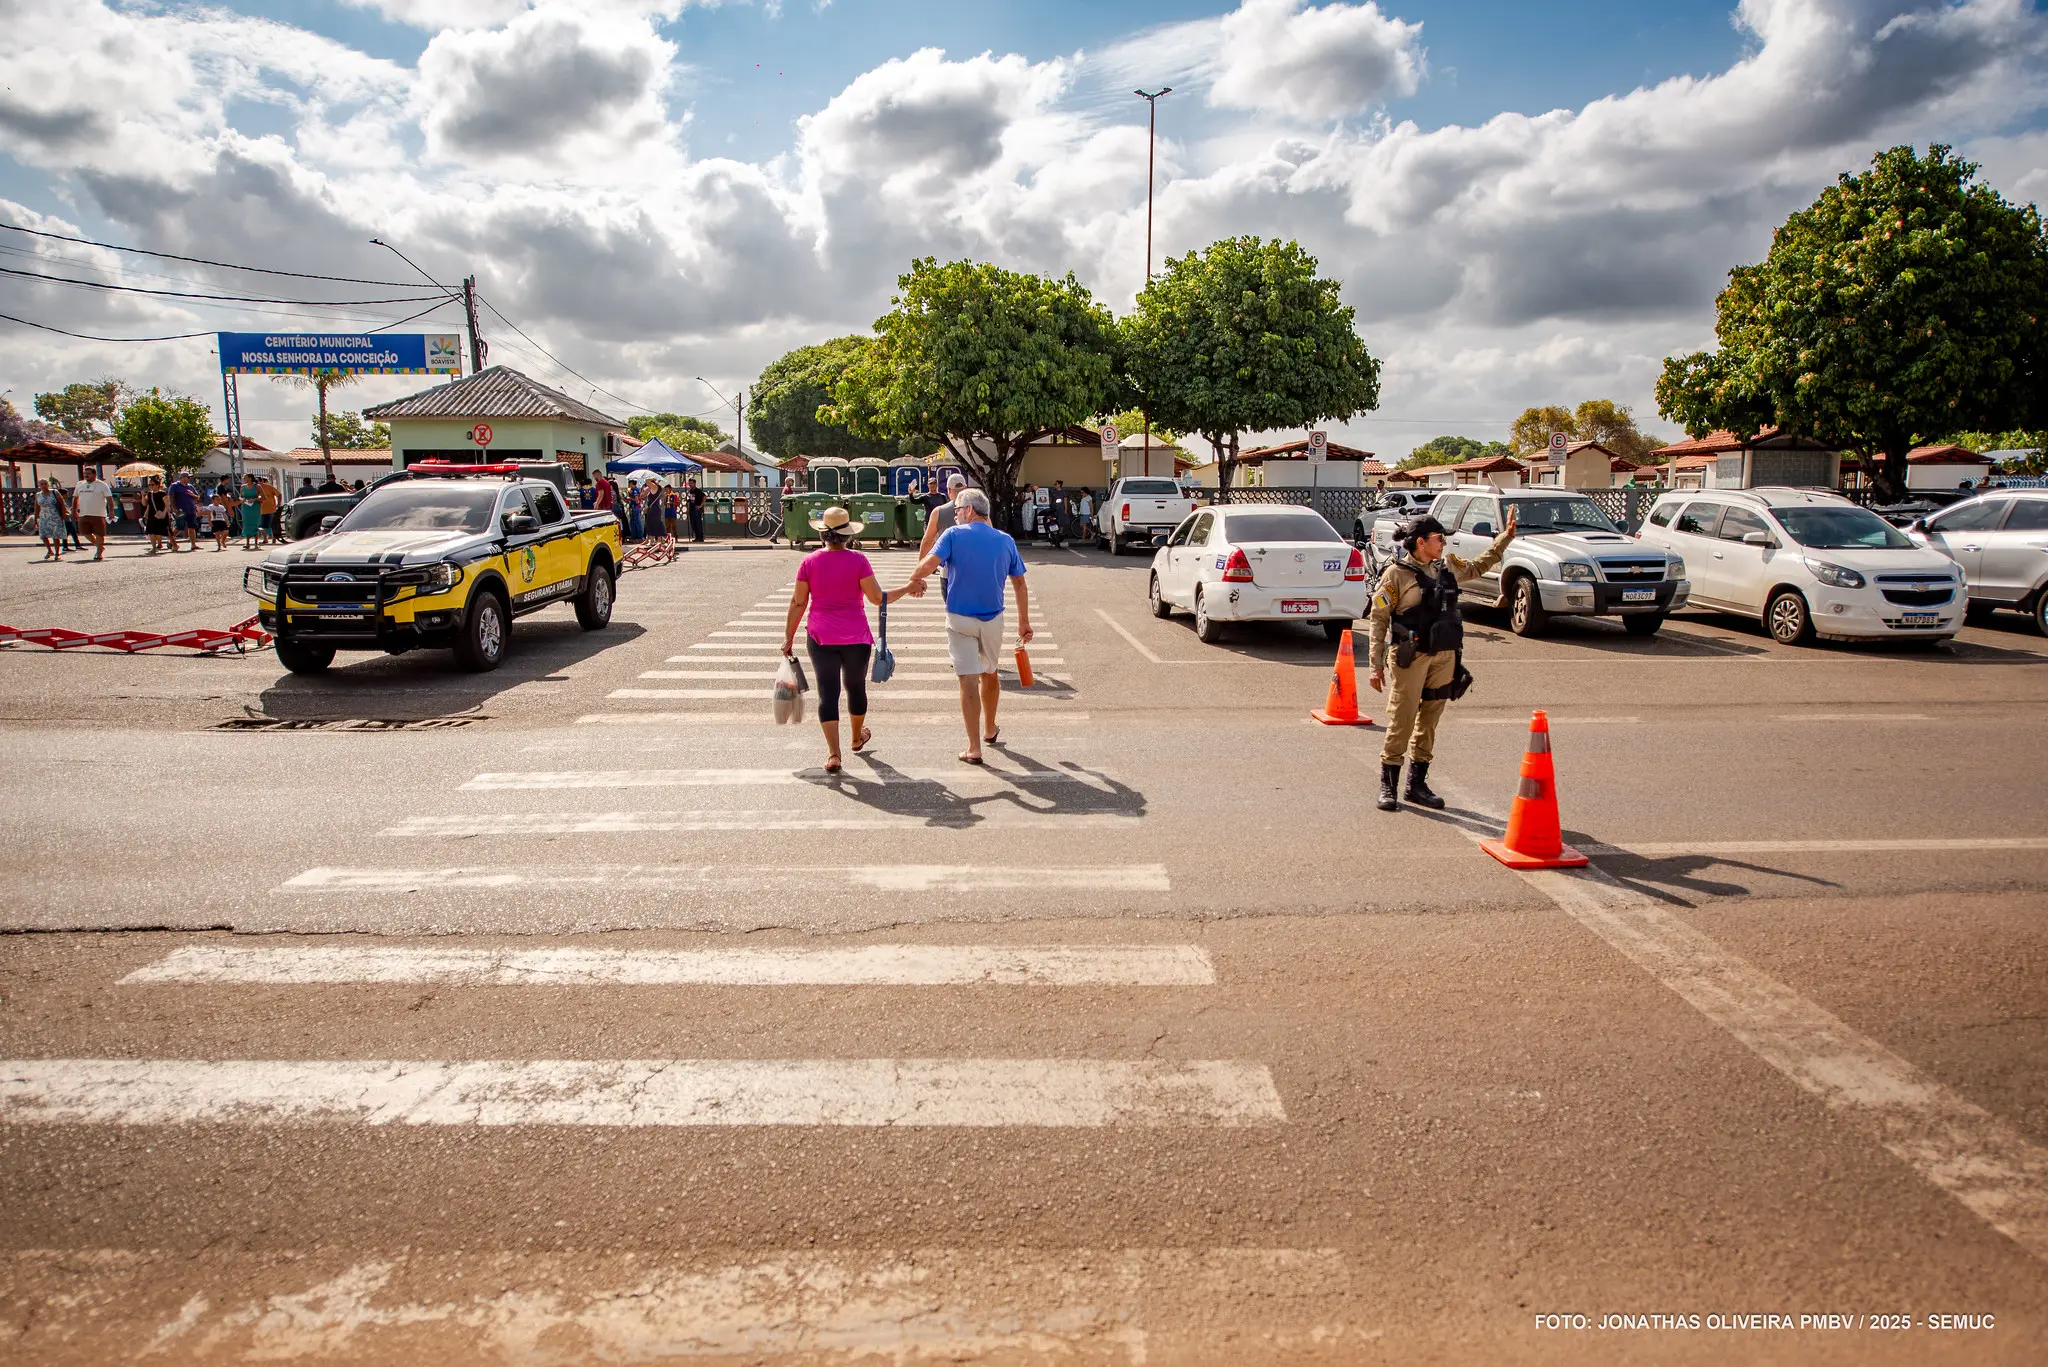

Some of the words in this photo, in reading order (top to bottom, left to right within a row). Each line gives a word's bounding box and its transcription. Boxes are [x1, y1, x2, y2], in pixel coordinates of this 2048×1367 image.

[265, 335, 318, 348] CEMITÉRIO
[319, 336, 373, 348] MUNICIPAL
[242, 352, 274, 363] NOSSA
[276, 352, 318, 363] SENHORA
[320, 352, 337, 363] DA
[339, 350, 398, 367] CONCEIÇÃO
[1106, 430, 1112, 439] E
[1315, 435, 1321, 444] E
[1556, 436, 1562, 445] E
[1324, 562, 1340, 570] 727
[523, 585, 556, 602] SEGURANÇA
[556, 579, 573, 593] VIÁRIA
